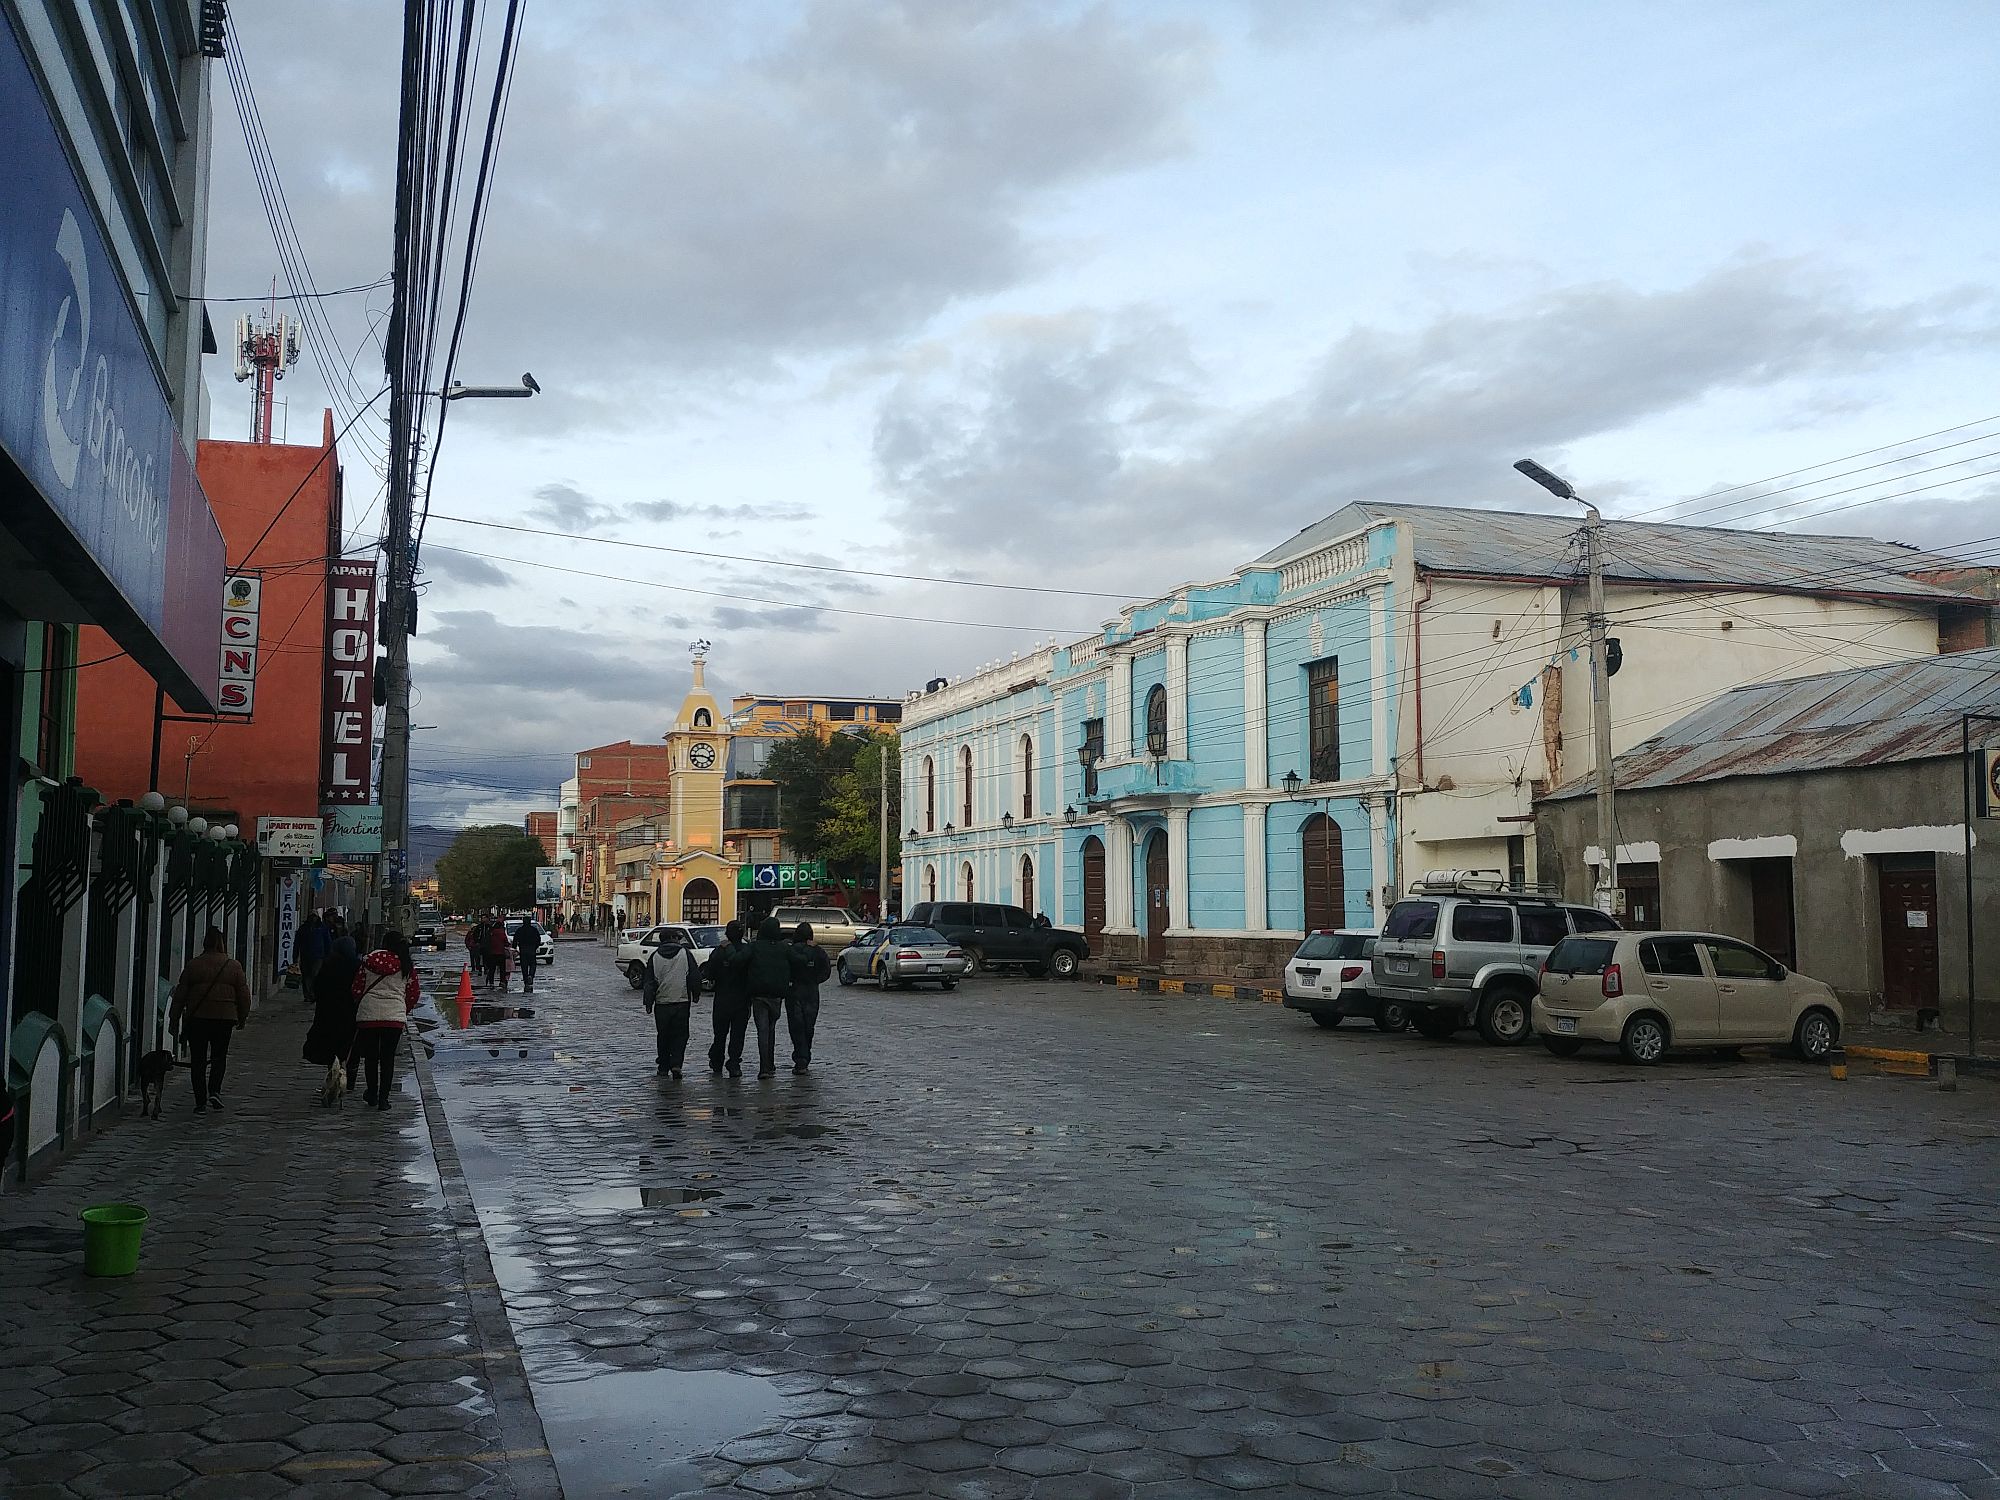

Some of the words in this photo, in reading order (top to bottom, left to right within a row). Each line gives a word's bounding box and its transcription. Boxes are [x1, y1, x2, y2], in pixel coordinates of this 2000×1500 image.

[87, 354, 160, 554] Bancofie
[329, 566, 374, 577] APART
[220, 616, 252, 707] CNS
[332, 587, 369, 785] HOTEL
[265, 822, 291, 830] APART
[280, 893, 292, 968] FARMACIA
